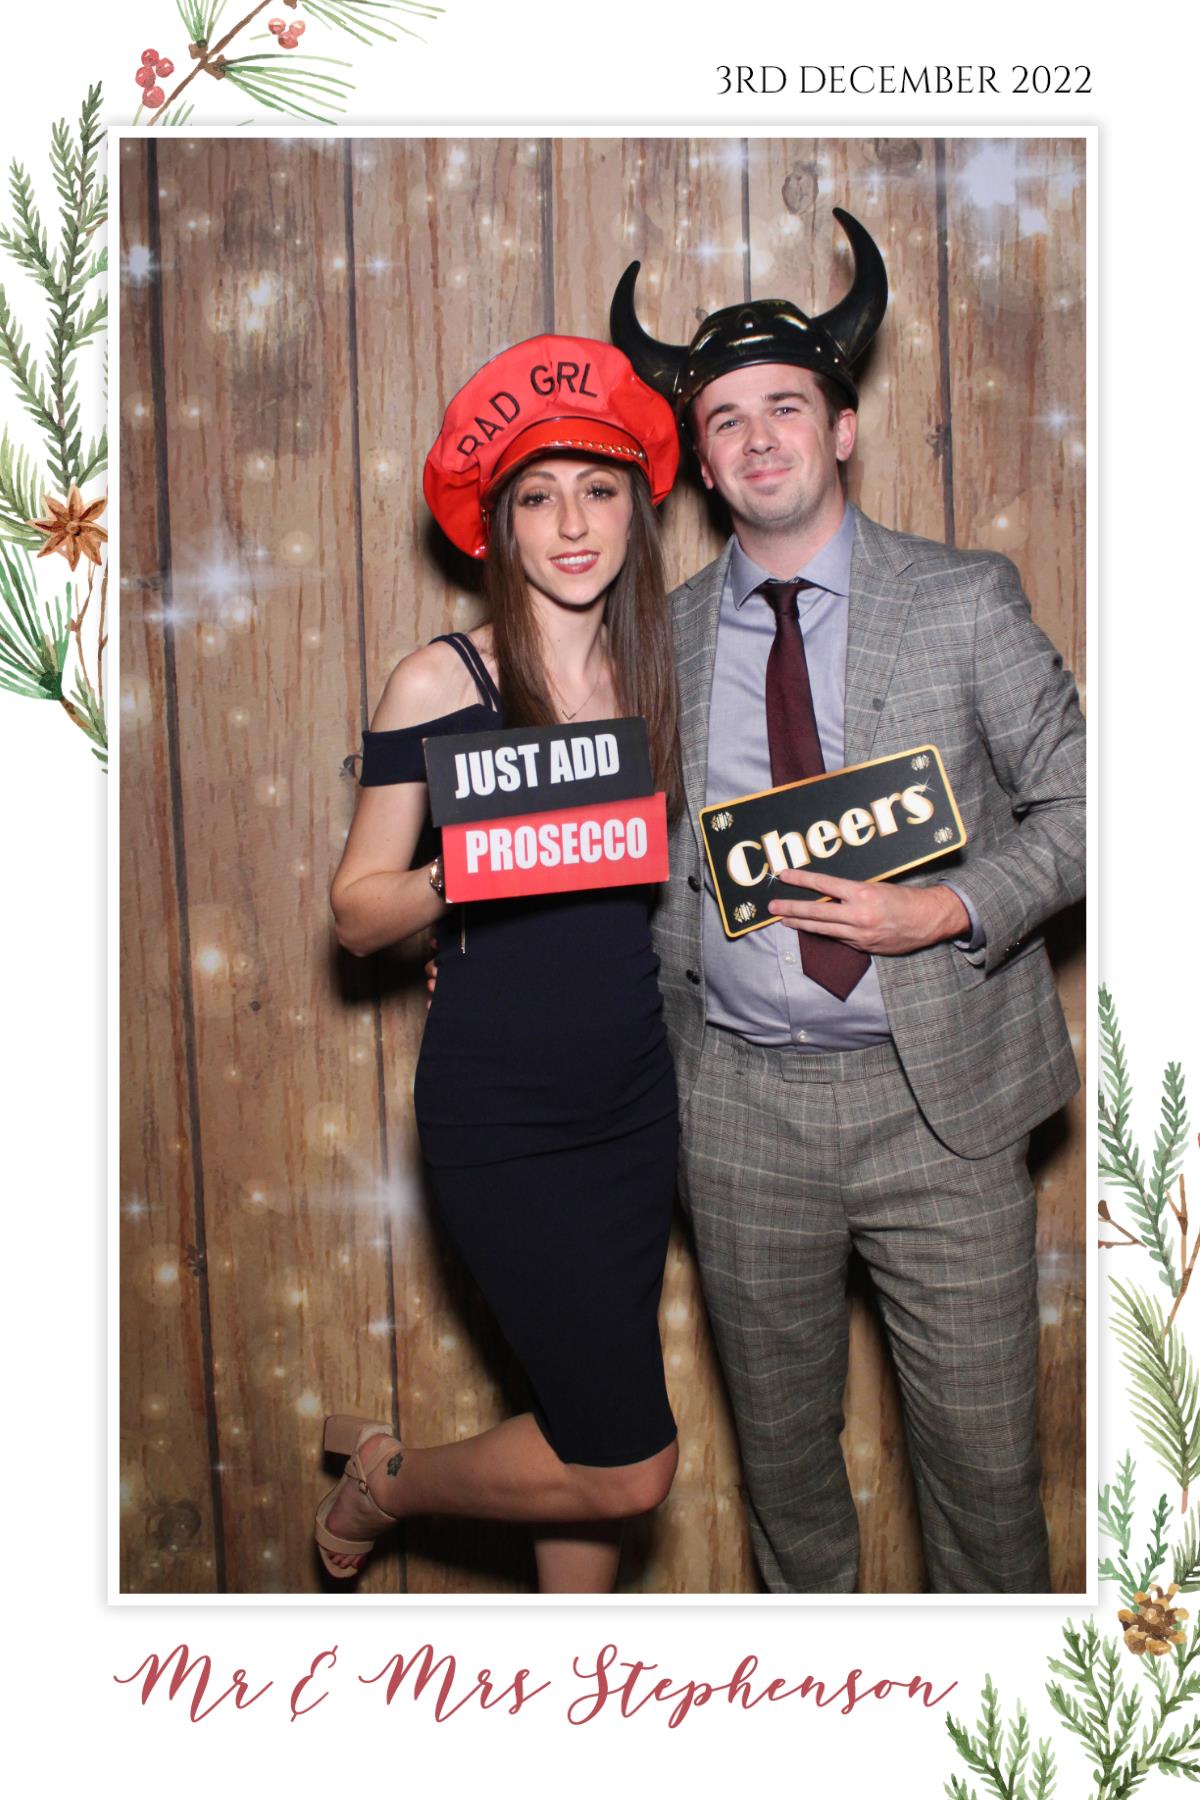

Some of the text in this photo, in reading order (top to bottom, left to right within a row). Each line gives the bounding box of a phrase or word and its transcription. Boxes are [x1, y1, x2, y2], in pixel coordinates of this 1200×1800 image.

[454, 733, 620, 799] JUST ADD
[465, 816, 648, 874] PROSECCO
[726, 782, 935, 887] Cheers
